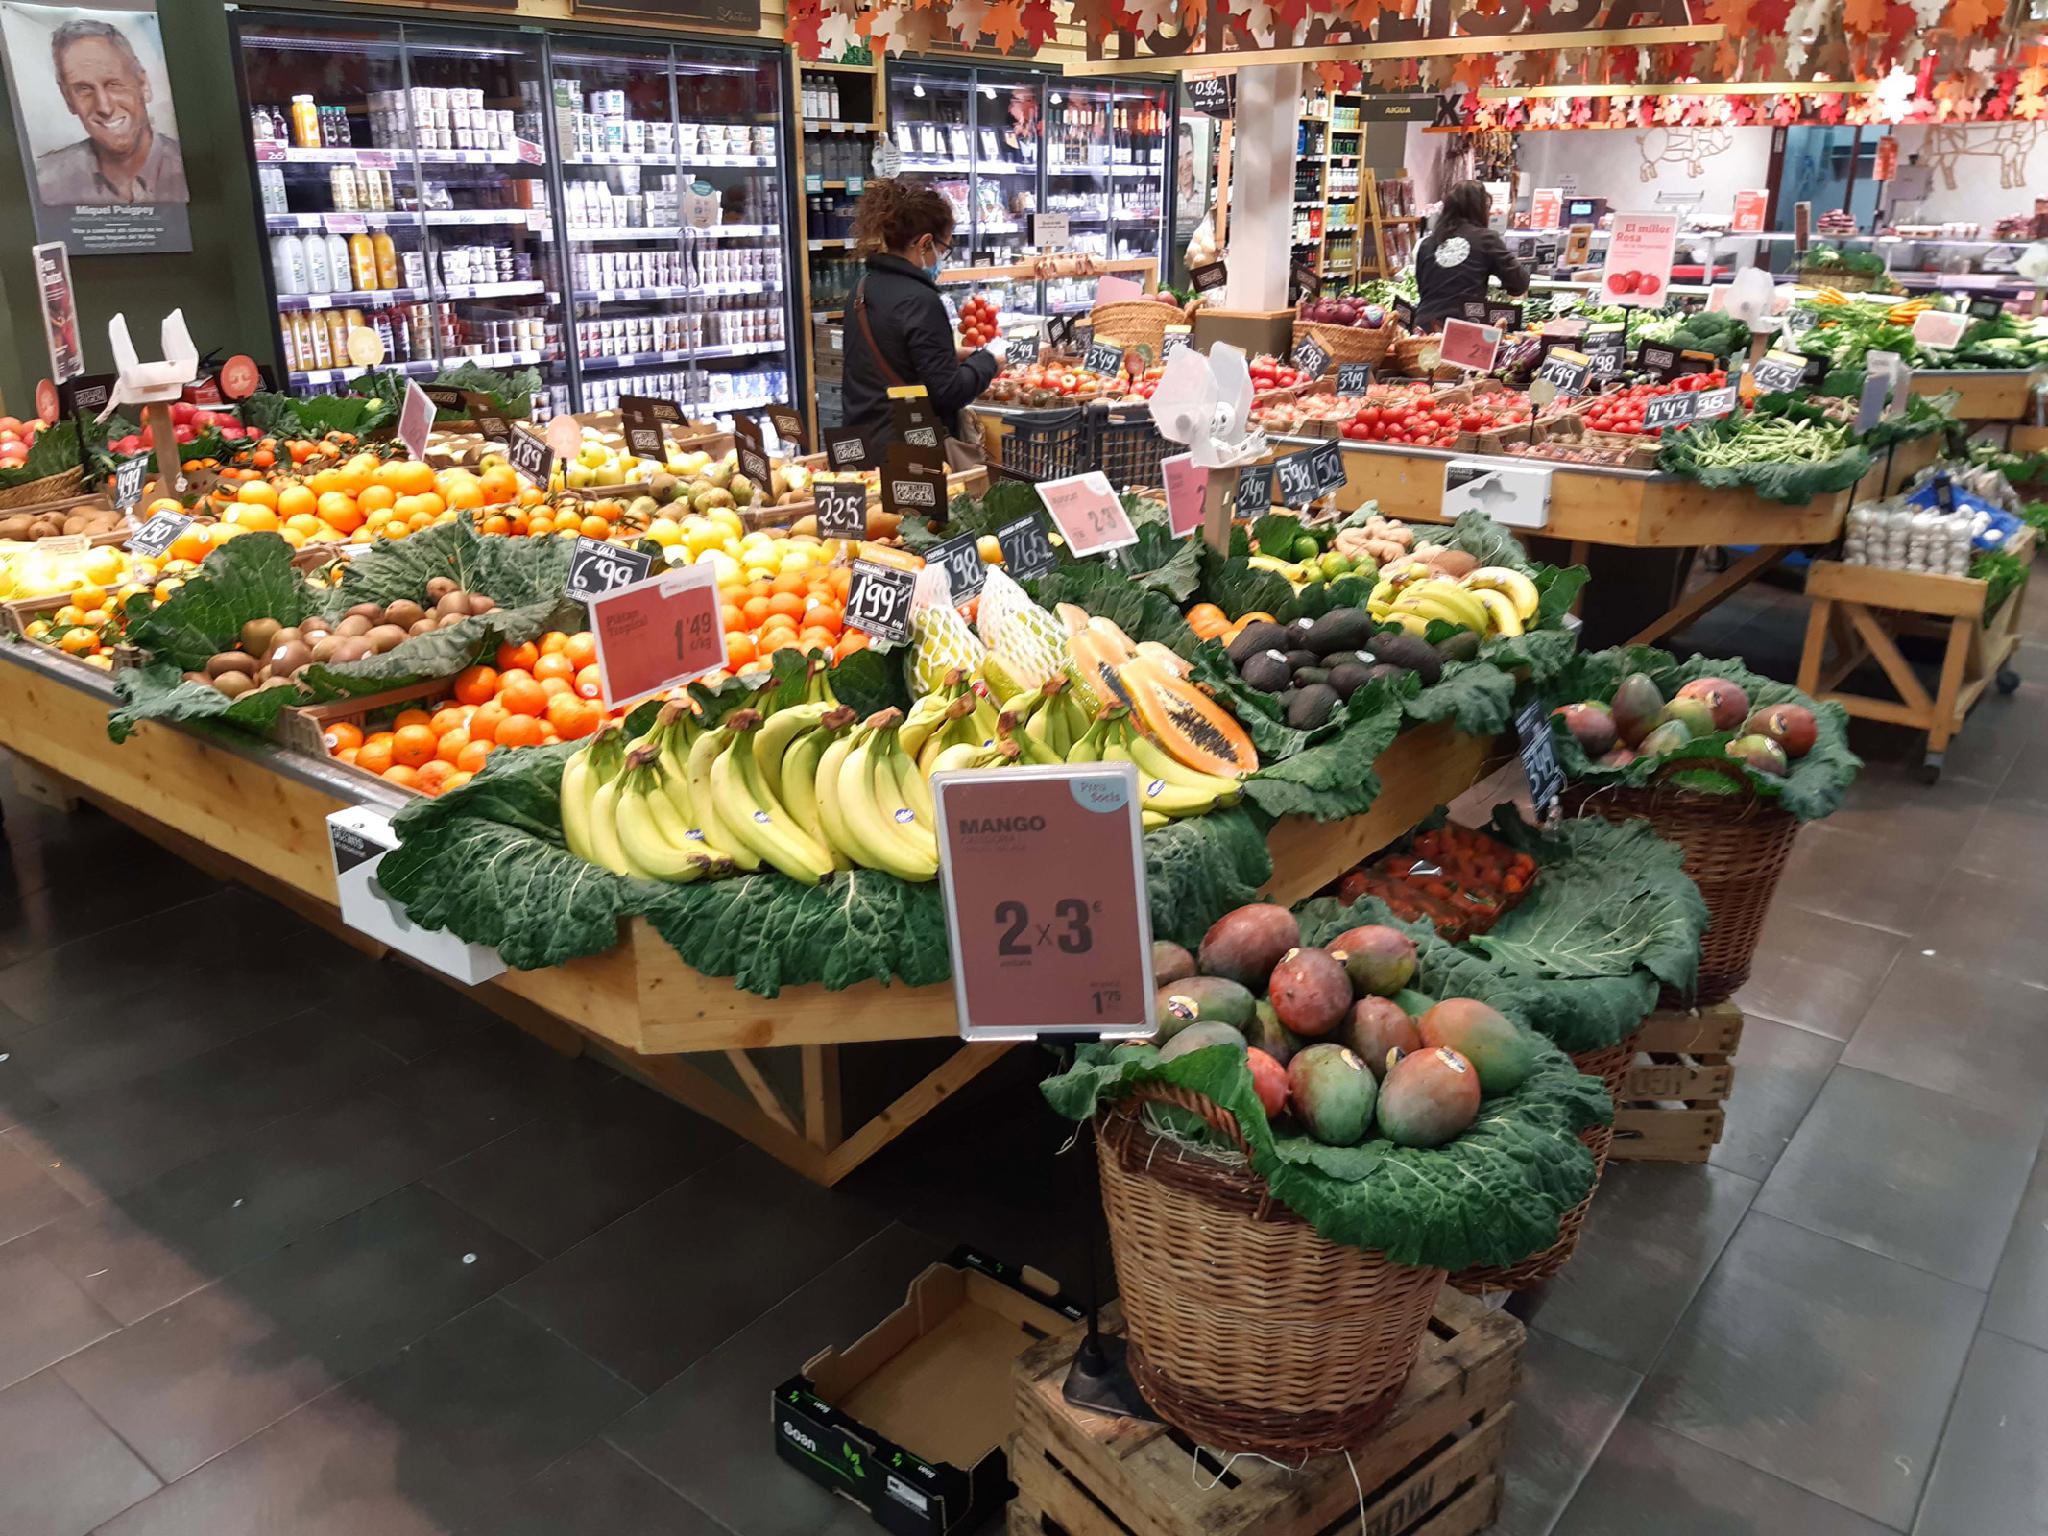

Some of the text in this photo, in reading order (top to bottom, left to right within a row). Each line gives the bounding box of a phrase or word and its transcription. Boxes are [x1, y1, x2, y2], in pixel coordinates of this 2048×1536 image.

[849, 574, 897, 622] 1'99
[674, 612, 712, 661] 1'49
[959, 815, 1047, 835] MANGO
